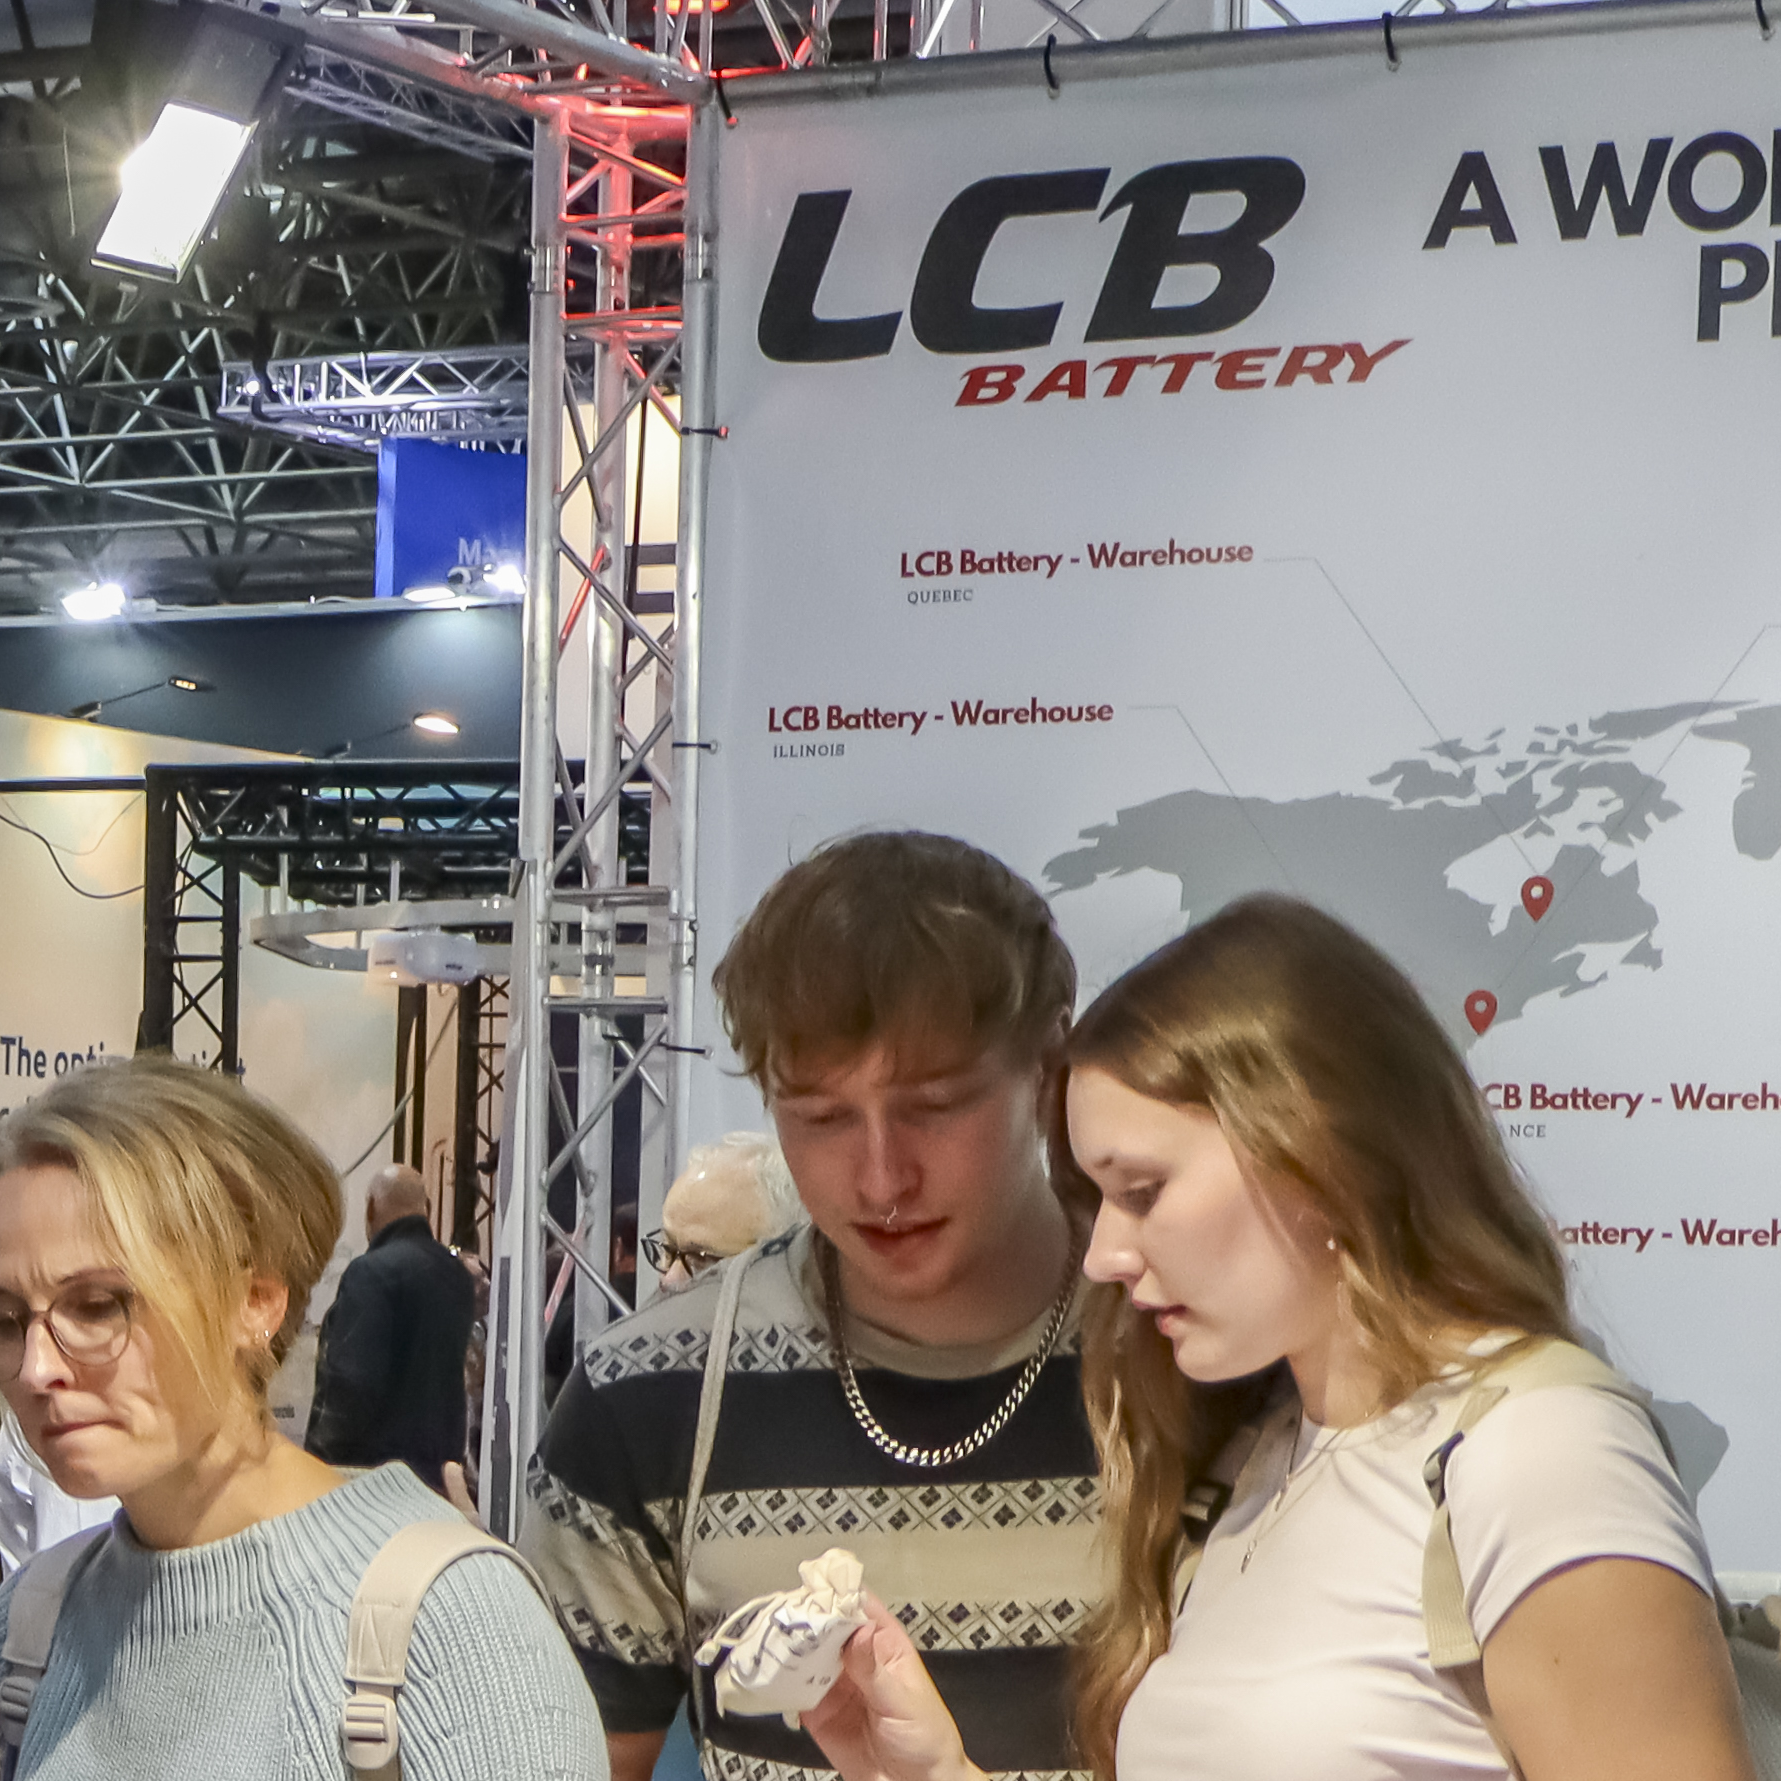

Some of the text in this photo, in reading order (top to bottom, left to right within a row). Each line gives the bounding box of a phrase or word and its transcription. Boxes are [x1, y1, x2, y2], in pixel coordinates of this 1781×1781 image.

[1422, 131, 1781, 250] A WO
[757, 156, 1306, 364] LCB
[1696, 243, 1781, 342] P
[955, 337, 1413, 407] BATTERY
[901, 550, 953, 578] LCB
[960, 549, 1063, 579] Battery
[1087, 538, 1254, 569] Warehouse
[907, 589, 974, 605] QUEBEC
[768, 705, 820, 733] LCB
[826, 704, 928, 736] Battery
[950, 696, 1114, 727] Warehouse
[773, 743, 846, 759] ILLINOIS
[0, 1035, 47, 1079] The
[1482, 1082, 1523, 1111] CB
[1530, 1082, 1644, 1119] Battery
[1670, 1081, 1781, 1111] Wareh
[1558, 1220, 1655, 1254] attery
